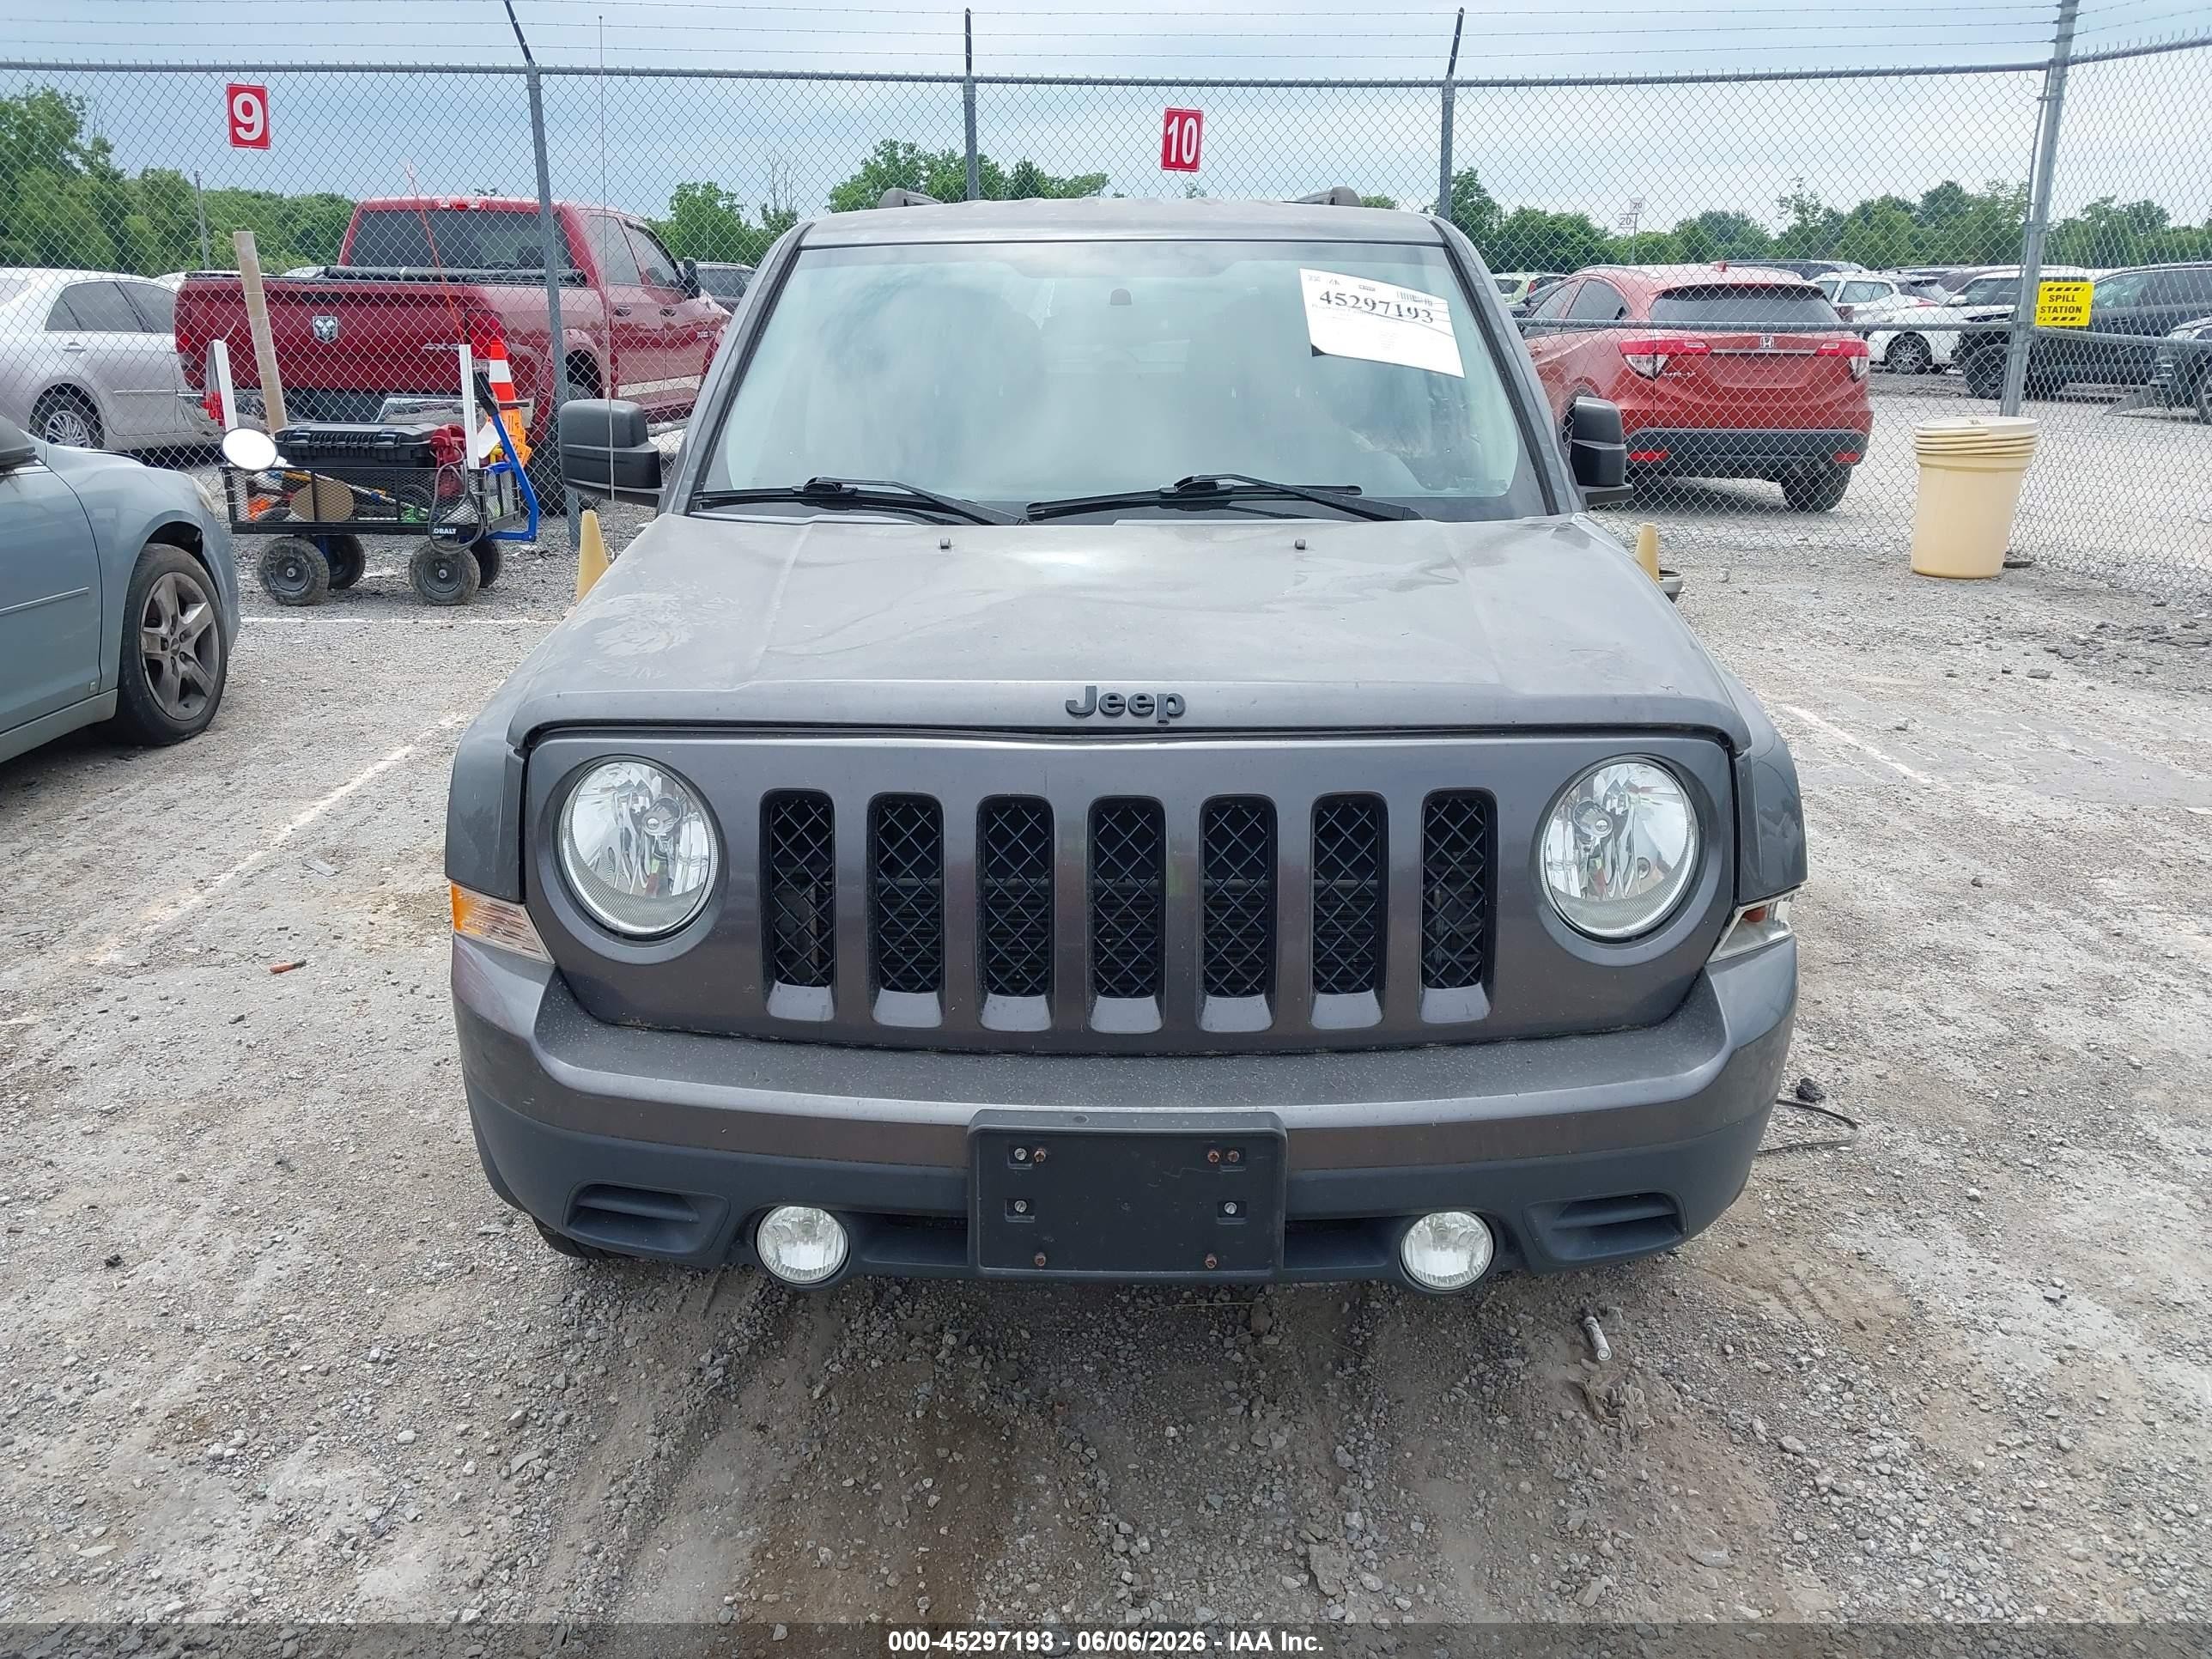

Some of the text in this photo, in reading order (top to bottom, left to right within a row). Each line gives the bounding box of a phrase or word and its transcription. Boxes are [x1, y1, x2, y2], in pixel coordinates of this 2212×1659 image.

[233, 92, 264, 141] 9
[1167, 116, 1198, 164] 10
[1319, 290, 1434, 323] 45297193
[1065, 685, 1186, 725] Jeep
